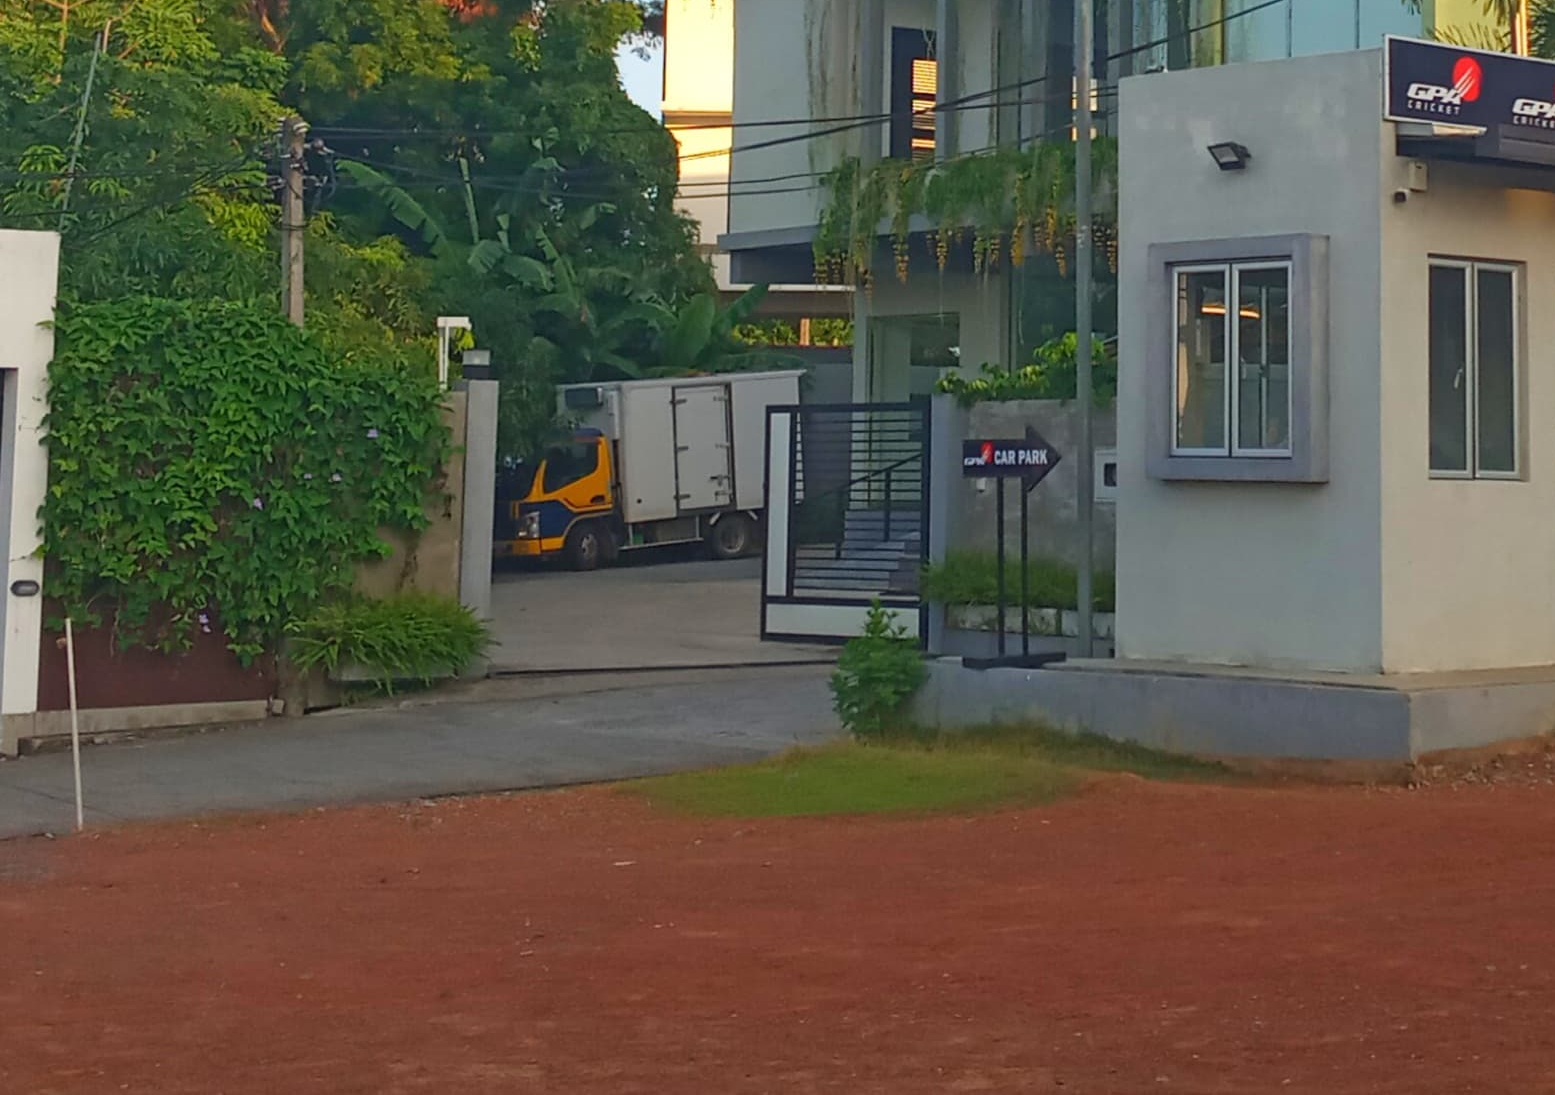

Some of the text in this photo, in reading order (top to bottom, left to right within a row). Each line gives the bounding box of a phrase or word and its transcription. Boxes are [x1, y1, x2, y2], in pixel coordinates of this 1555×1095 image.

[1407, 82, 1462, 105] GPA
[1407, 99, 1460, 115] CRICKET
[994, 450, 1016, 465] CAR
[1018, 449, 1048, 465] PARK
